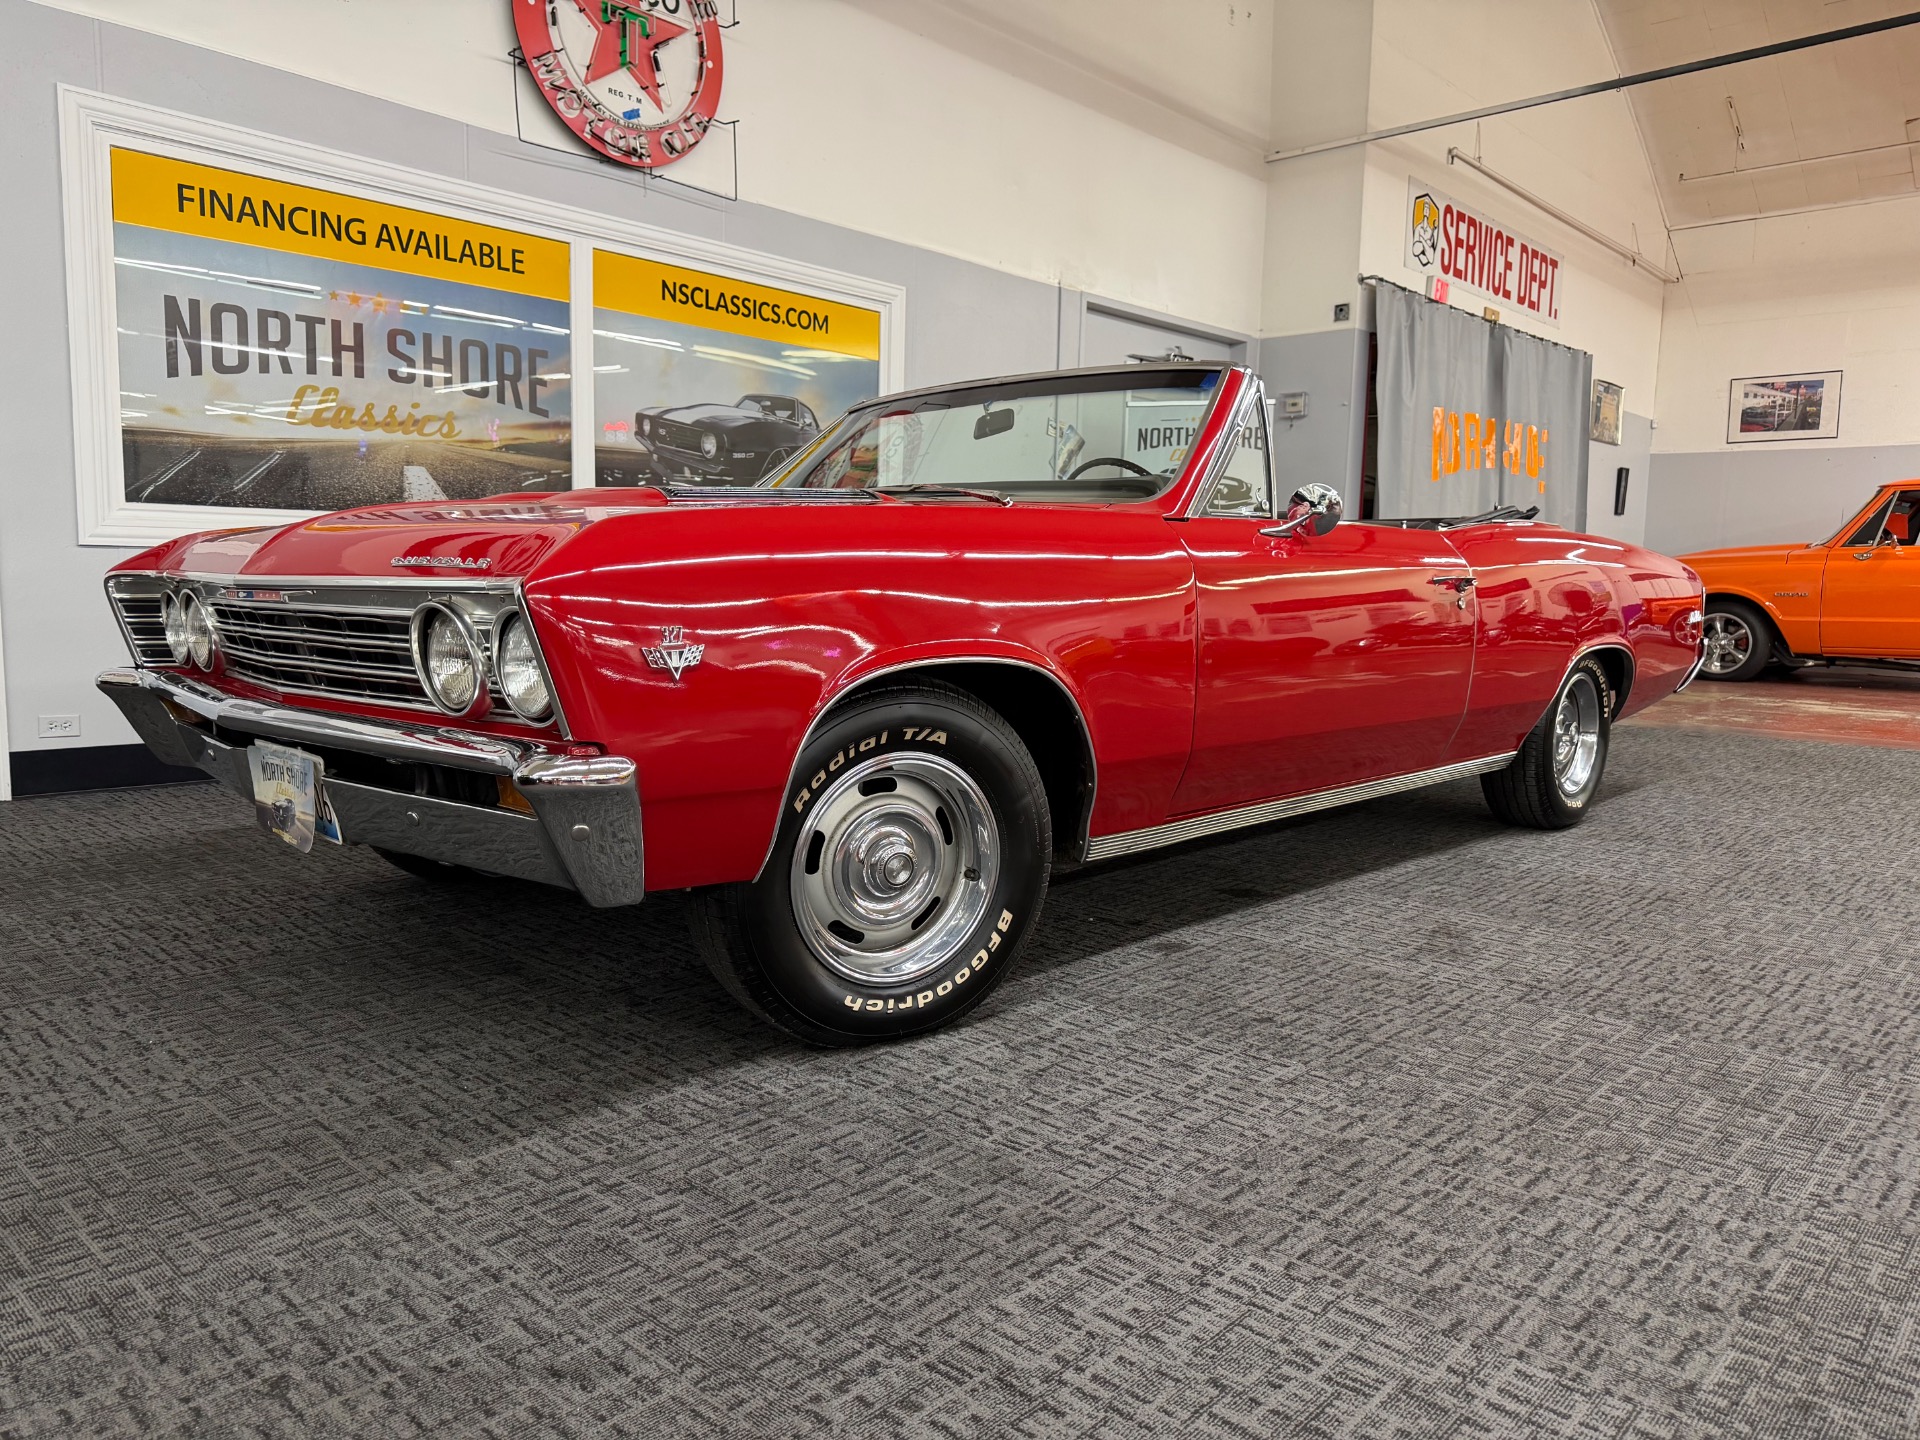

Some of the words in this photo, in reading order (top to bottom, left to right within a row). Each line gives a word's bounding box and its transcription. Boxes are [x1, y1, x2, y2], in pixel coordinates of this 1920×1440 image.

[531, 51, 652, 163] MOTOR
[608, 115, 620, 124] THE
[176, 183, 367, 246] FINANCING
[375, 223, 526, 275] AVAILABLE
[1440, 203, 1514, 302] SERVICE
[1517, 241, 1559, 320] DEPT.
[661, 279, 829, 334] NSCLASSICS.COM
[163, 294, 365, 378] NORTH
[386, 328, 550, 419] SHORE
[285, 384, 462, 440] Classics
[390, 556, 492, 569] CHEVELLE
[661, 626, 683, 644] 327
[260, 758, 285, 783] NORTH
[793, 730, 888, 813] Radial
[902, 727, 948, 746] T/A
[843, 907, 1013, 1014] BFGoodrich
